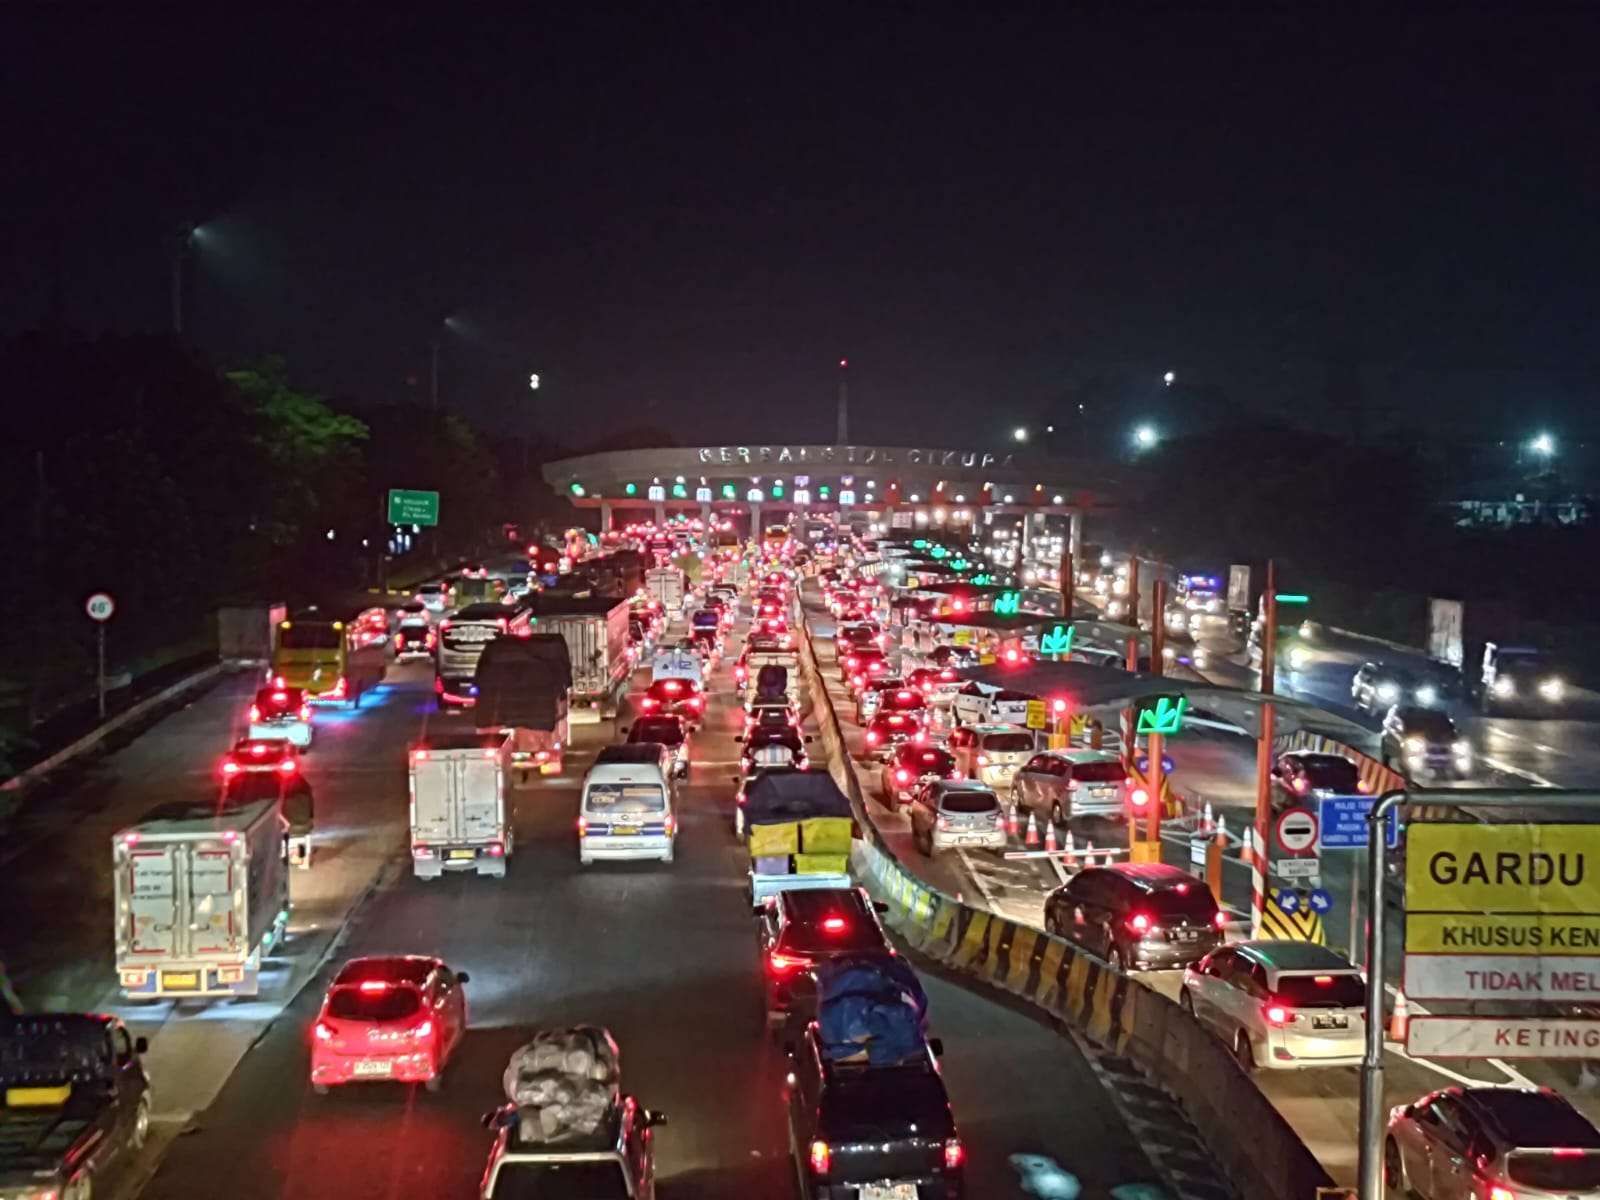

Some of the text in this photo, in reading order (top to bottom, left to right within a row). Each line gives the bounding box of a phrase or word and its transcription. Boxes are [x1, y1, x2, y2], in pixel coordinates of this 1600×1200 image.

[699, 446, 836, 464] GERBA
[1429, 851, 1585, 886] GARDU
[1442, 926, 1600, 947] KHUSUS KEN
[1465, 970, 1600, 992] TIDAK MEL
[1495, 1027, 1600, 1048] KETING
